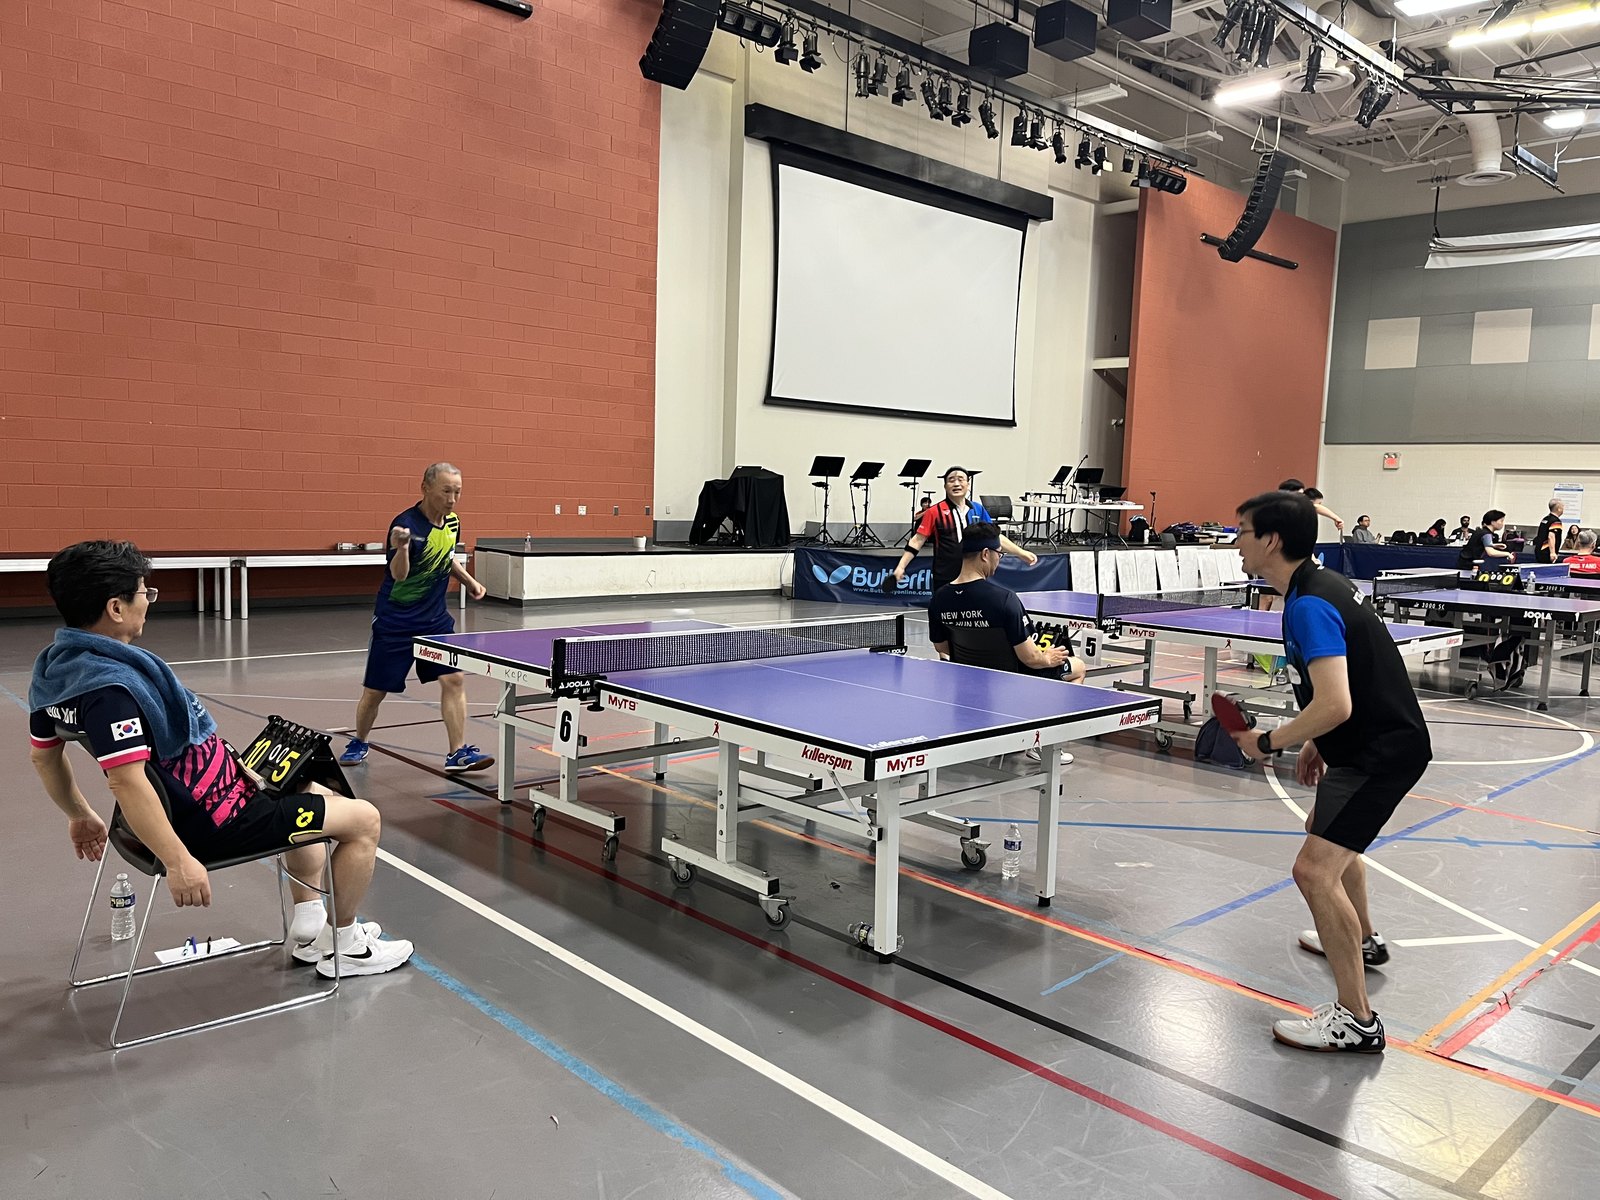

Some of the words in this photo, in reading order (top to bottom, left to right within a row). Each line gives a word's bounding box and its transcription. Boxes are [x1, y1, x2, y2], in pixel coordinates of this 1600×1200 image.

[941, 611, 958, 620] NEW
[960, 609, 983, 619] YORK
[974, 619, 990, 628] KIM
[1523, 610, 1552, 620] JOOLA
[1038, 633, 1054, 652] 5
[1085, 637, 1097, 657] 5
[419, 646, 443, 661] killerspin
[565, 680, 591, 689] JOOLA
[608, 694, 639, 711] MyT9
[560, 710, 573, 742] 6
[244, 737, 272, 769] 10
[271, 751, 301, 782] 5
[801, 745, 853, 771] killerspin
[886, 753, 928, 773] MyT9
